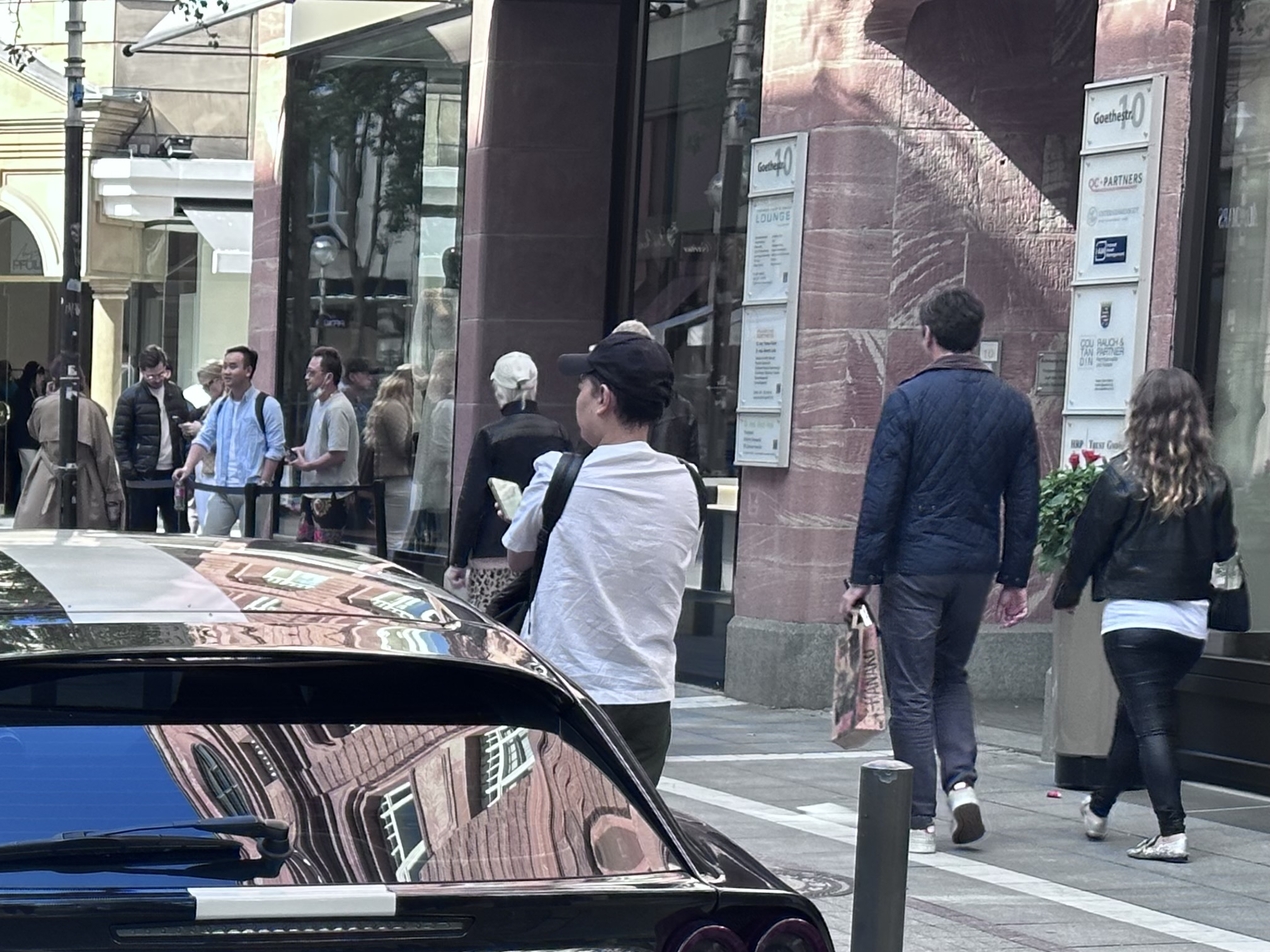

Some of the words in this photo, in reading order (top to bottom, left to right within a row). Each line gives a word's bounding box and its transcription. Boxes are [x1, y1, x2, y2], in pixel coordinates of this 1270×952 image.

[1119, 92, 1146, 130] 10
[775, 146, 793, 177] 10
[755, 211, 791, 224] LOUNGE
